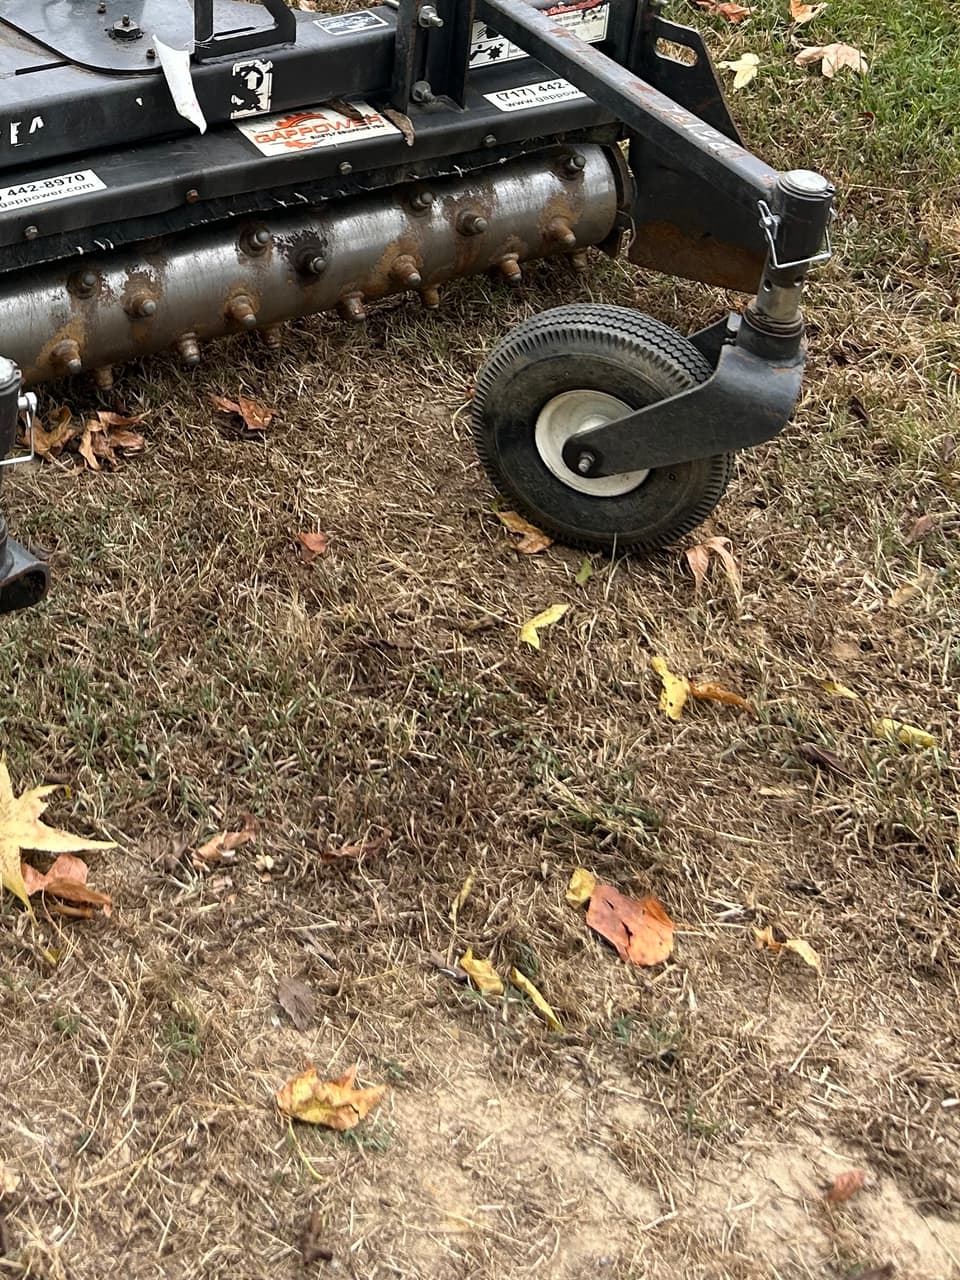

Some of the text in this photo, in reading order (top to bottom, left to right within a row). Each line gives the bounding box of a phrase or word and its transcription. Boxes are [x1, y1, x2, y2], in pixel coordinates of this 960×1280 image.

[496, 81, 569, 102] (717) 442-
[505, 90, 578, 108] www.gappow
[7, 174, 86, 196] 442-8970
